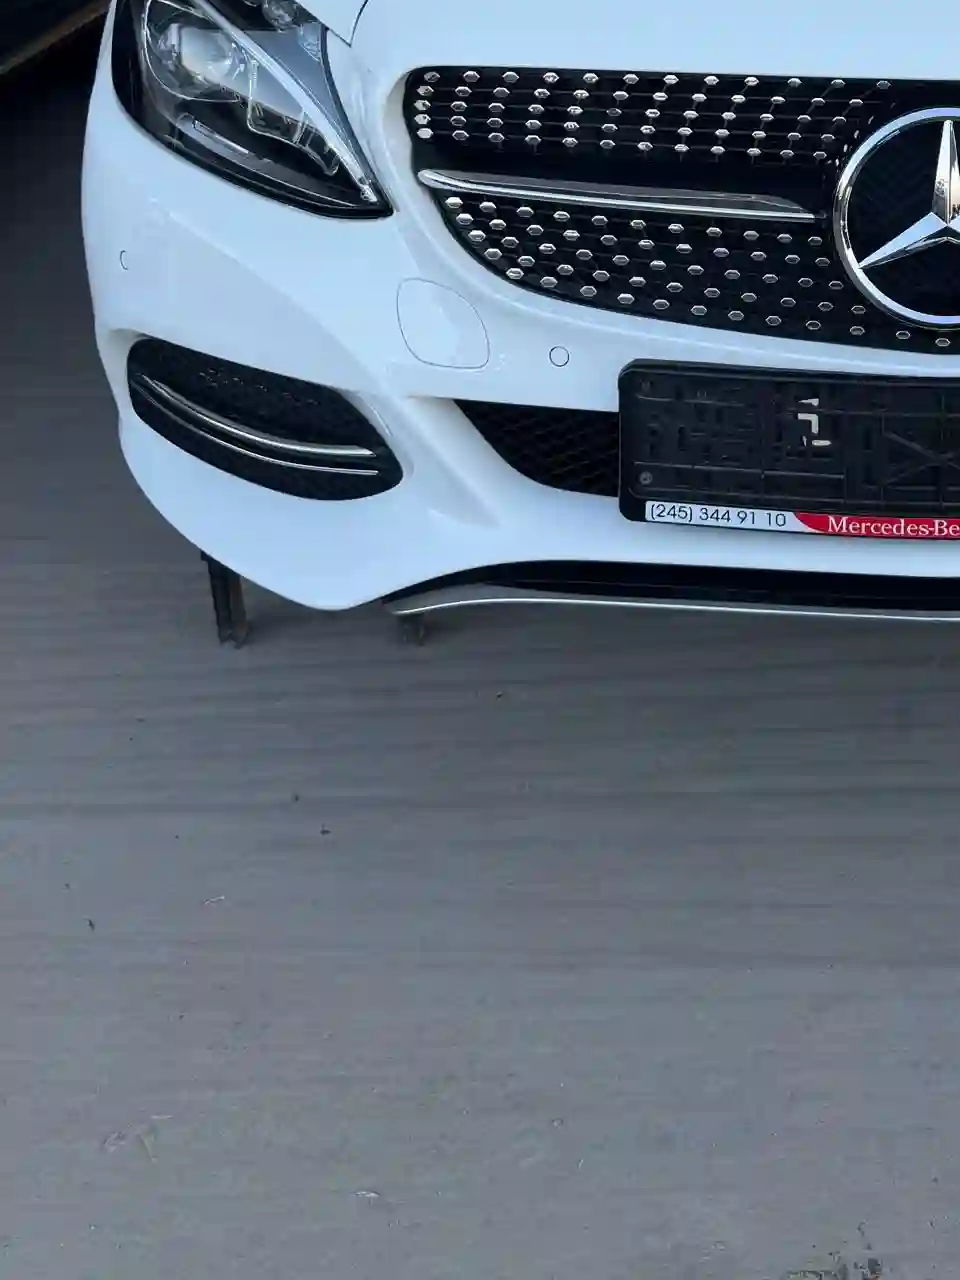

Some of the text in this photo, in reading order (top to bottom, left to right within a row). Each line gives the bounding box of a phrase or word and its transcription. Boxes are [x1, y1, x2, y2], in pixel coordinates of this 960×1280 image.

[650, 503, 693, 522] (245)
[699, 507, 731, 523] 344
[737, 510, 756, 525] 91
[766, 512, 787, 527] 10
